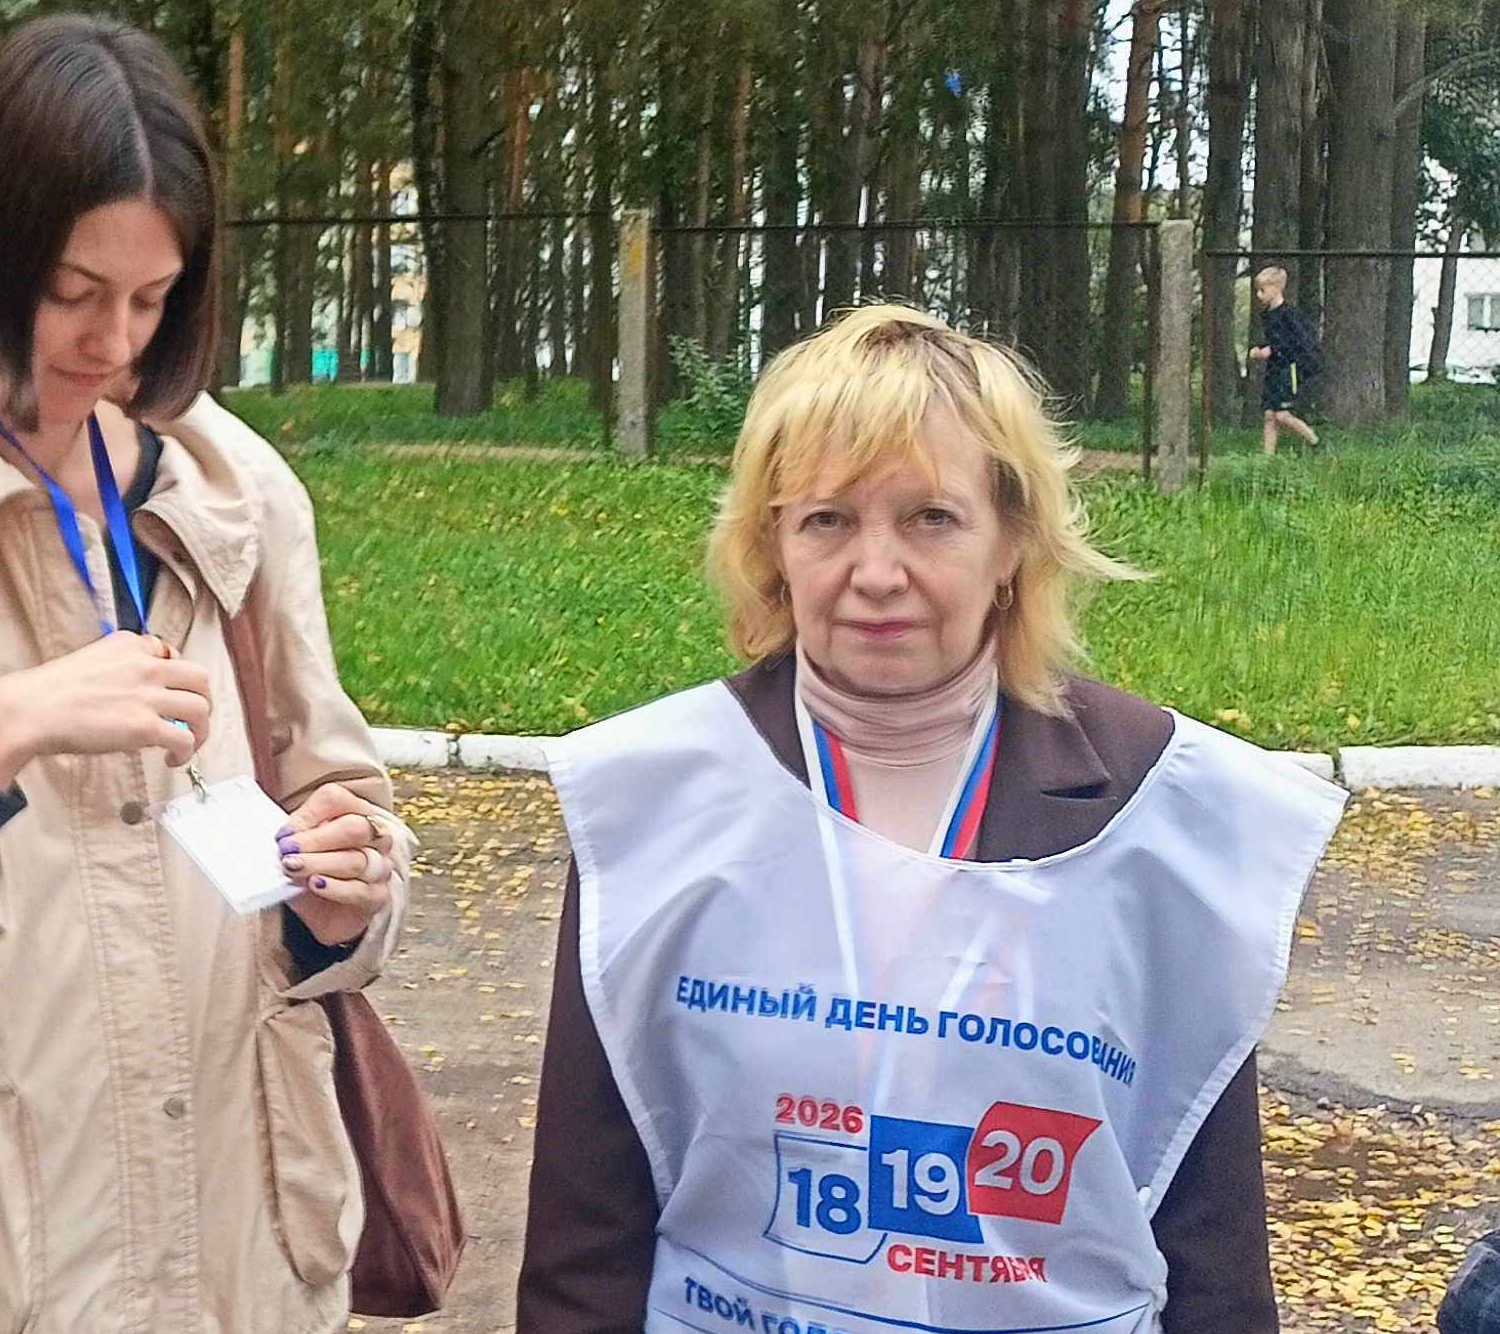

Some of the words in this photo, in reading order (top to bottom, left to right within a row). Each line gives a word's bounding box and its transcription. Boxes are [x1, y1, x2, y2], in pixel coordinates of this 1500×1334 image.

[676, 974, 818, 1022] ЕДИНЫЙ
[824, 995, 929, 1036] ДЕНЬ
[774, 1093, 864, 1134] 2026
[787, 1168, 862, 1235] 18
[881, 1149, 961, 1216] 19
[974, 1130, 1065, 1196] 20
[683, 1276, 757, 1333] ТВОЙ
